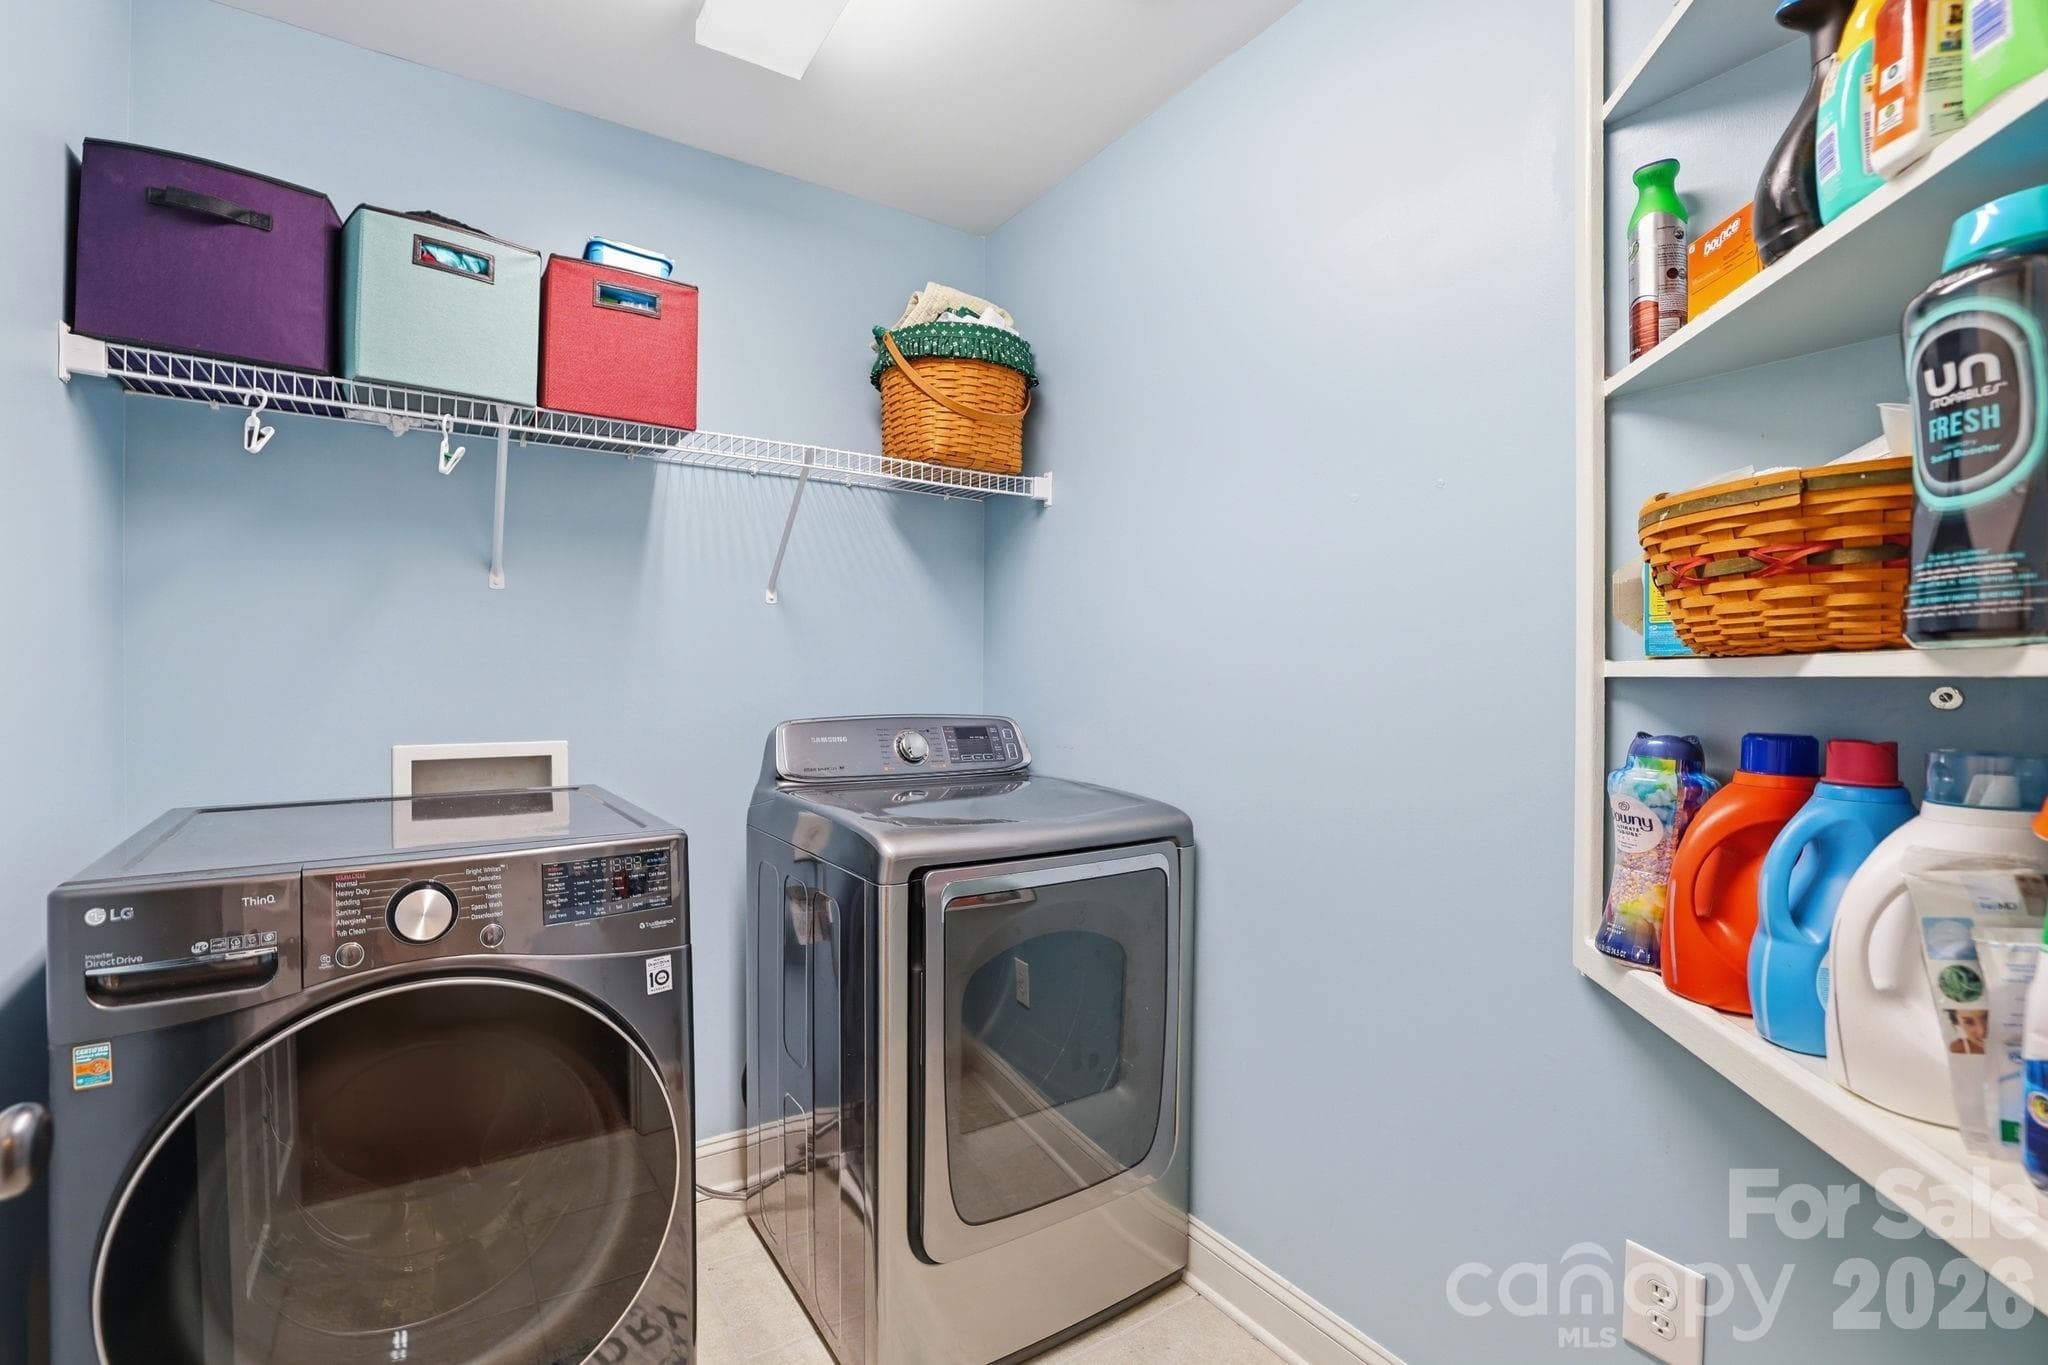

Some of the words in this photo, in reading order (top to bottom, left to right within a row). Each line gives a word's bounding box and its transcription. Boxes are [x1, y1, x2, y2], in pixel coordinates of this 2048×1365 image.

[1703, 217, 1742, 257] bounce
[1929, 404, 2001, 443] FRESH
[1614, 811, 1654, 832] owny
[335, 880, 358, 888] Normal
[335, 889, 355, 898] Heavy
[355, 887, 371, 895] Duty
[241, 894, 276, 907] ThinQ
[335, 899, 361, 908] Bedding
[109, 907, 134, 922] LG
[335, 930, 348, 938] Tub
[348, 927, 367, 936] Clean
